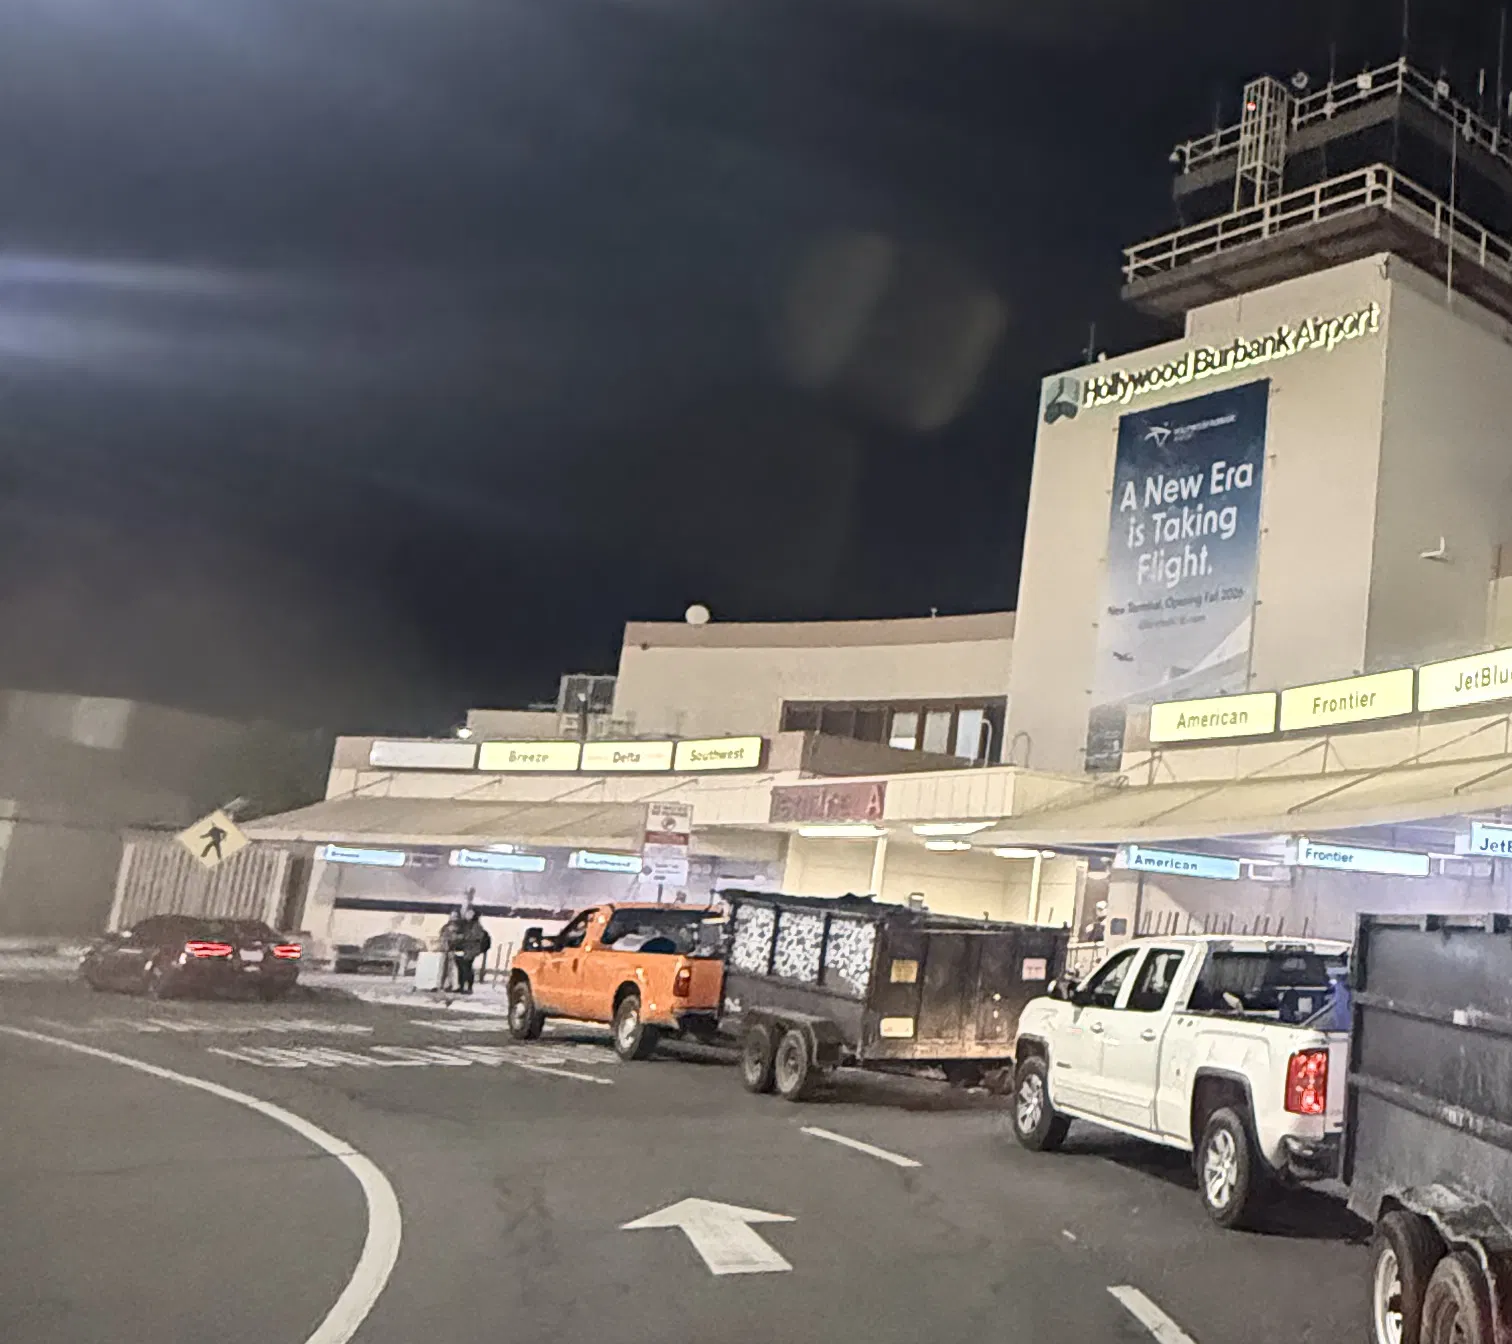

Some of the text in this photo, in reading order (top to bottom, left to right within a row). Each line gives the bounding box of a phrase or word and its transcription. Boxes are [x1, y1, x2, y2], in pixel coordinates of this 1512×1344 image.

[1084, 302, 1379, 407] Hollywood Burbank Airport
[1120, 461, 1253, 512] A New Era
[1127, 504, 1237, 549] is Taking
[1137, 544, 1213, 589] Flight.
[1312, 691, 1377, 715] Frontier
[1177, 709, 1249, 730] American
[508, 751, 549, 763] Breeze
[690, 748, 744, 763] Southwest
[1134, 854, 1198, 871] American
[1305, 847, 1354, 863] Frontier
